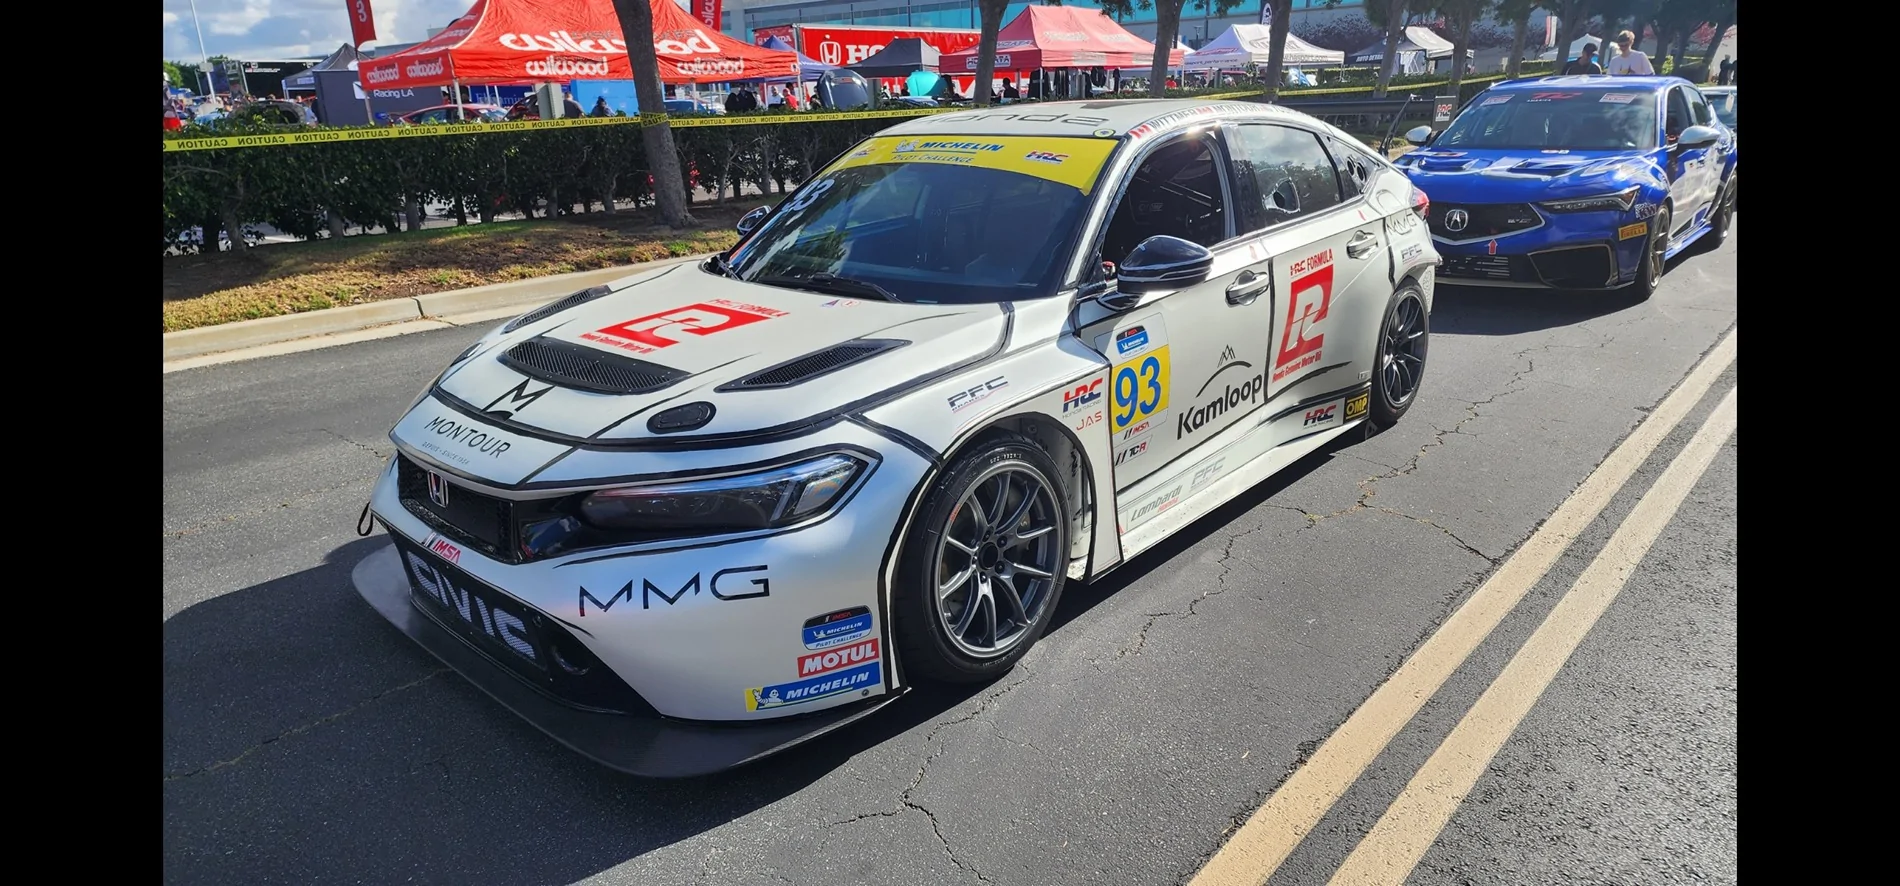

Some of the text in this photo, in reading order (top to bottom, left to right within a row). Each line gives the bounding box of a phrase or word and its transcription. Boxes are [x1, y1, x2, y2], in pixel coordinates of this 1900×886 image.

[526, 56, 609, 75] wilwood
[374, 88, 415, 99] Racing LA
[1150, 111, 1197, 129] WITTMER
[919, 140, 1005, 152] MICHELIN
[1025, 150, 1069, 162] HRC
[918, 154, 975, 163] CHALLENGE
[1307, 248, 1333, 272] FORMULA
[947, 375, 1008, 408] PFC
[1063, 378, 1103, 413] HRC
[1116, 356, 1161, 427] 93
[1177, 374, 1263, 441] Kamloop
[1304, 403, 1337, 426] HRC
[1346, 397, 1368, 415] OMP
[1076, 411, 1102, 431] JAS
[424, 416, 512, 458] MONTOUR
[1129, 442, 1147, 457] TCR
[1192, 457, 1226, 485] PFC
[1131, 485, 1183, 522] Lombardi
[580, 564, 770, 617] MMG
[407, 550, 536, 660] CIVIC
[827, 622, 863, 634] MICHELIN
[833, 633, 862, 644] CHALLENGE
[803, 642, 876, 674] MOTUL
[786, 671, 870, 700] MICHELIN
